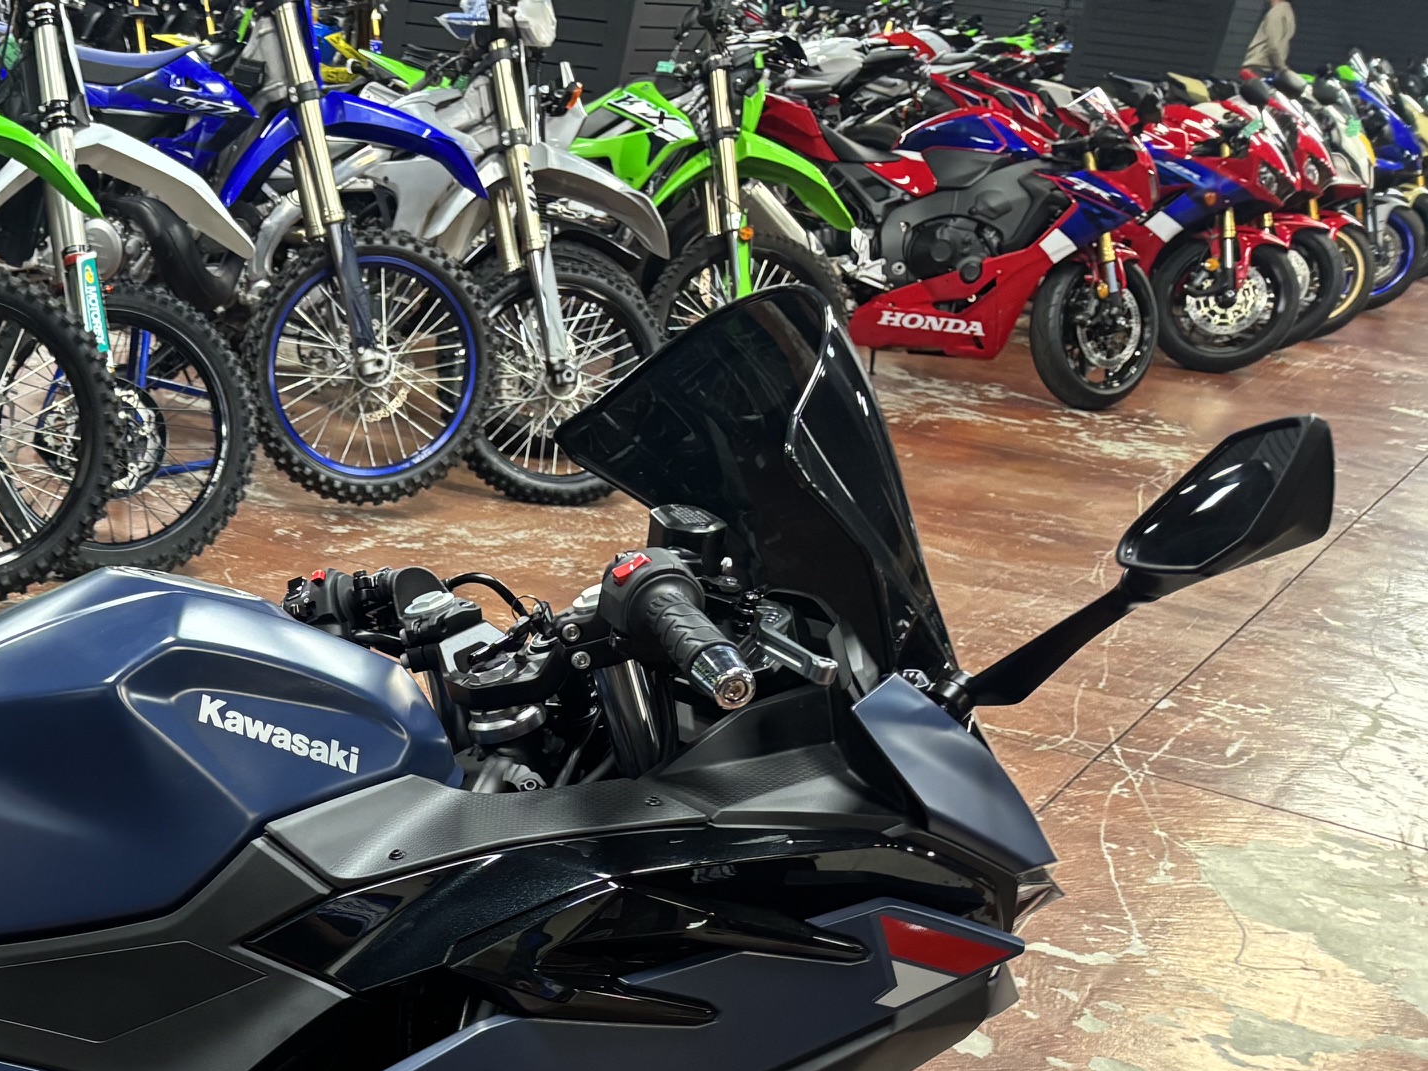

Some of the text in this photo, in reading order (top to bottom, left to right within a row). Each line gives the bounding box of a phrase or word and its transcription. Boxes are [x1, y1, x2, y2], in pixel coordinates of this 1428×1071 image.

[85, 285, 106, 346] MOTOREX
[876, 310, 985, 336] HONDA
[198, 694, 359, 774] Kawasaki
